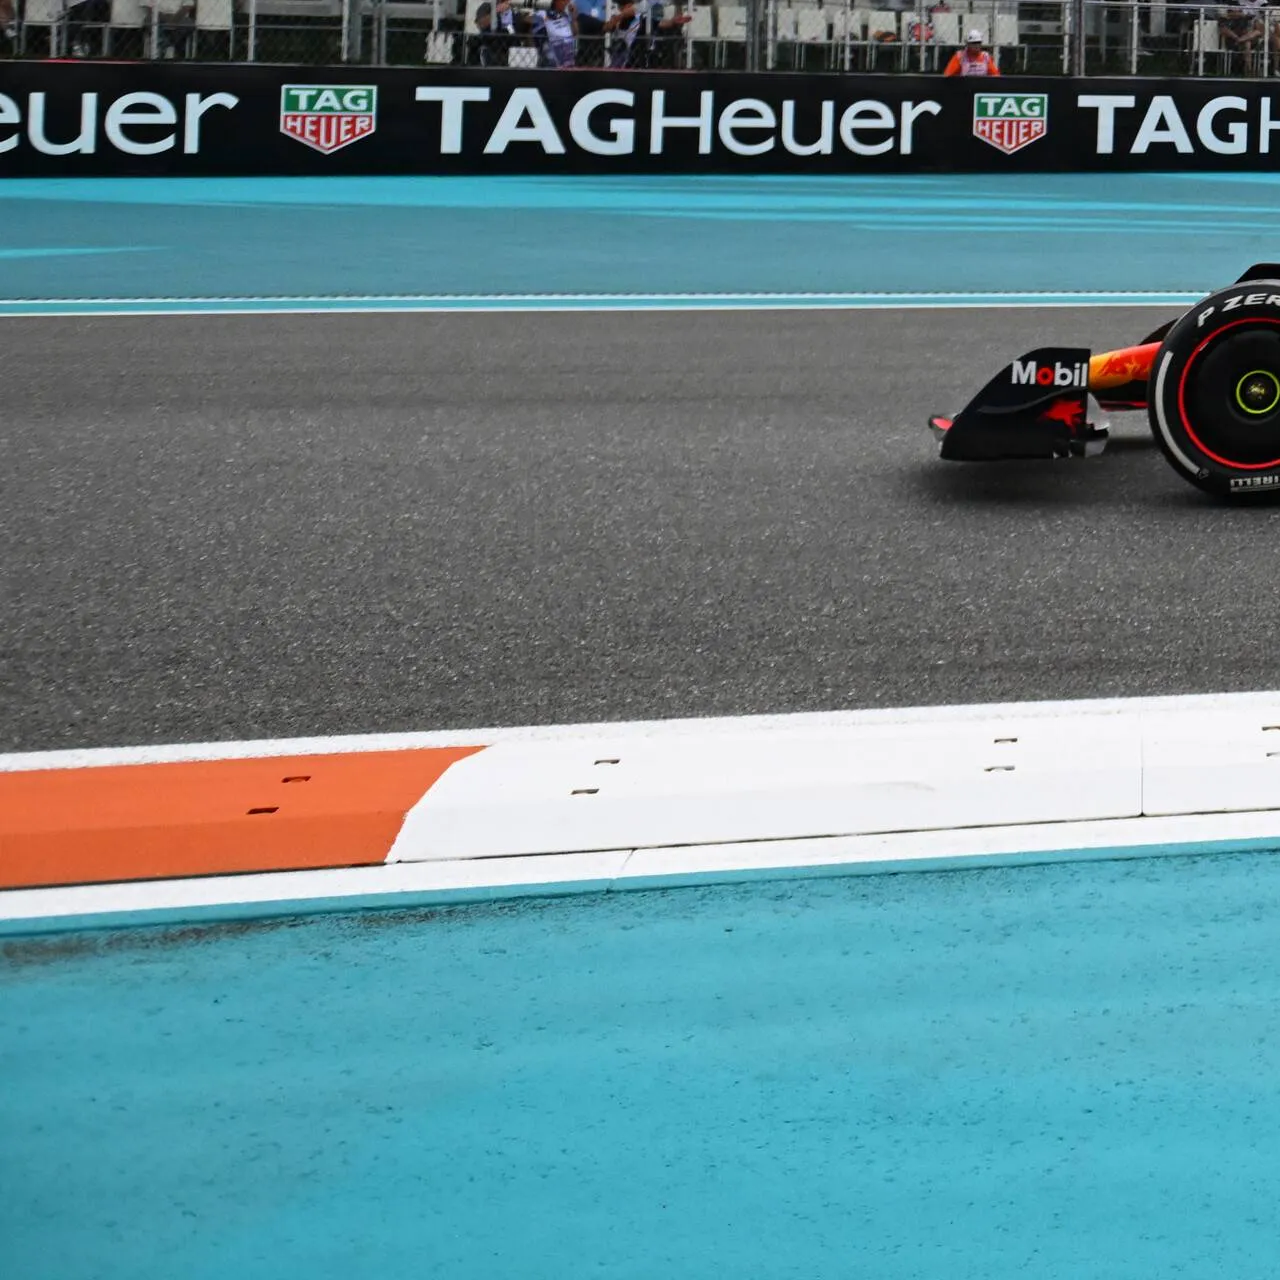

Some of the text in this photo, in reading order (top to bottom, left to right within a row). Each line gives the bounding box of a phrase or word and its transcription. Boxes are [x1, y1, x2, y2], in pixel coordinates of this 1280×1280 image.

[289, 89, 369, 111] TAG
[980, 97, 1041, 116] TAG
[0, 93, 238, 154] uer
[286, 115, 370, 148] HEUER
[978, 121, 1045, 151] HEUER
[1197, 306, 1215, 327] P
[1011, 360, 1088, 387] Mobil
